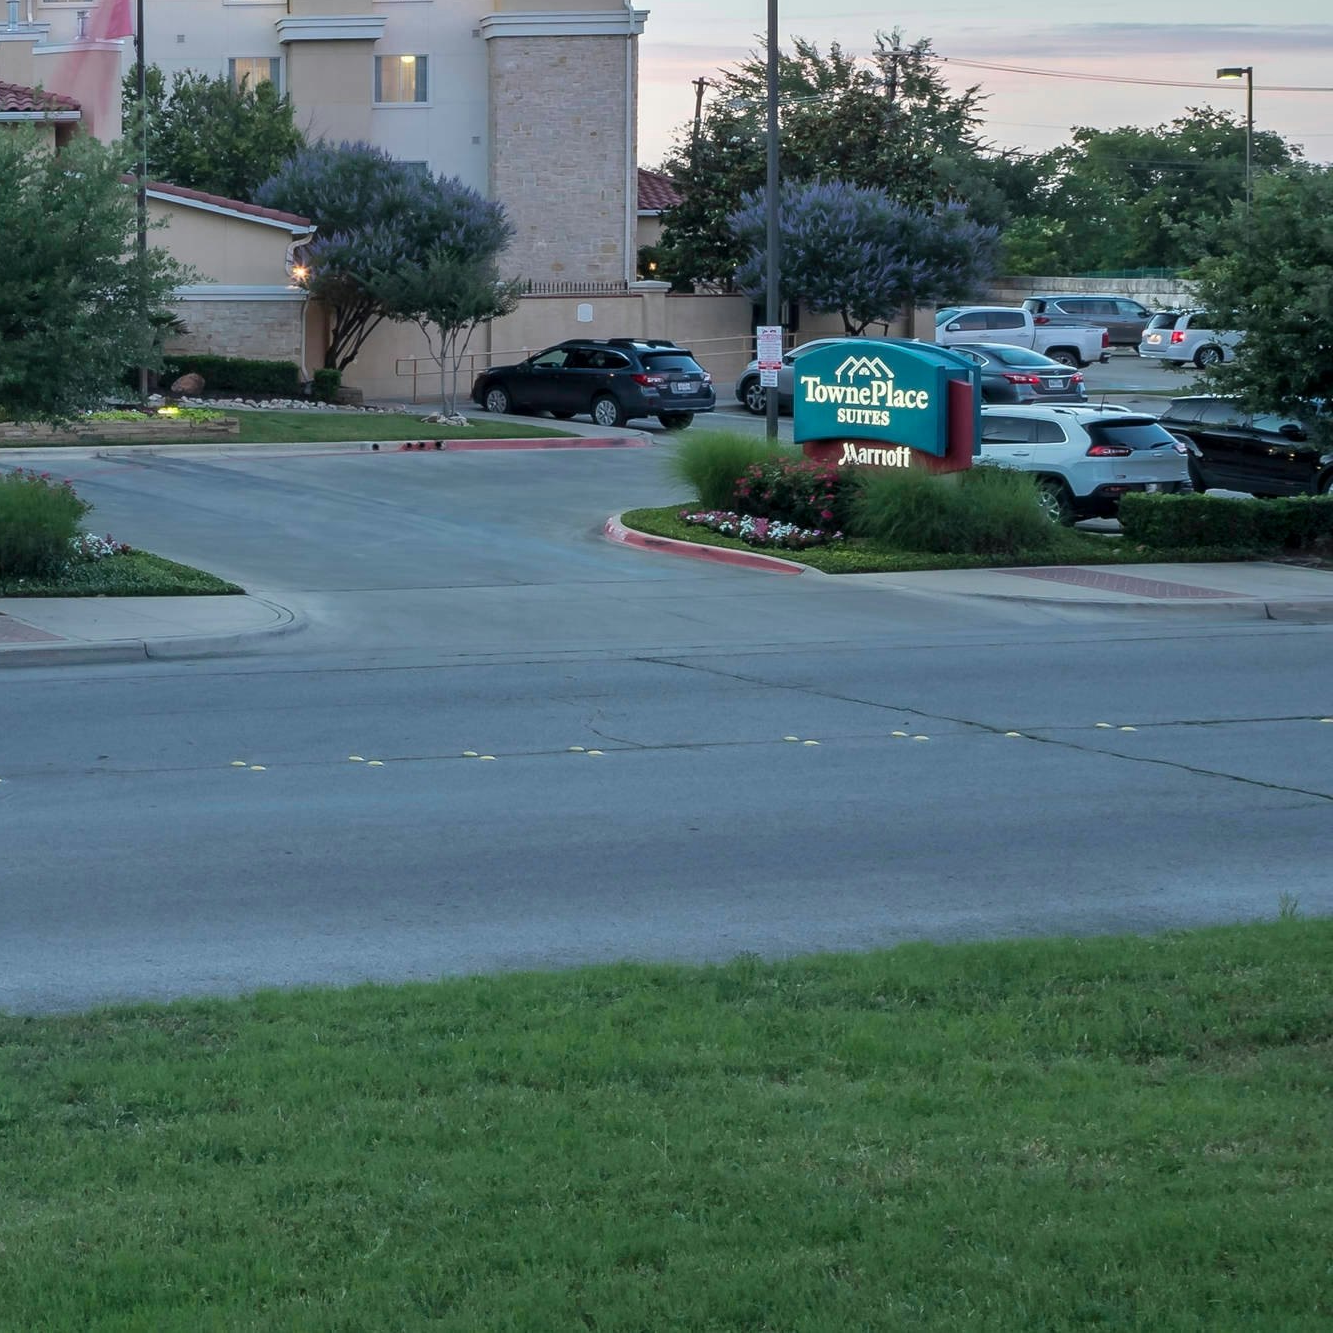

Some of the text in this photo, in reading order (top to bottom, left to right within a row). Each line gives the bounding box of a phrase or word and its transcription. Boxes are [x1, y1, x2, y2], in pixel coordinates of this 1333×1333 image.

[800, 376, 929, 409] TownePlace
[837, 408, 890, 426] SUITES
[838, 442, 911, 467] Marriott
